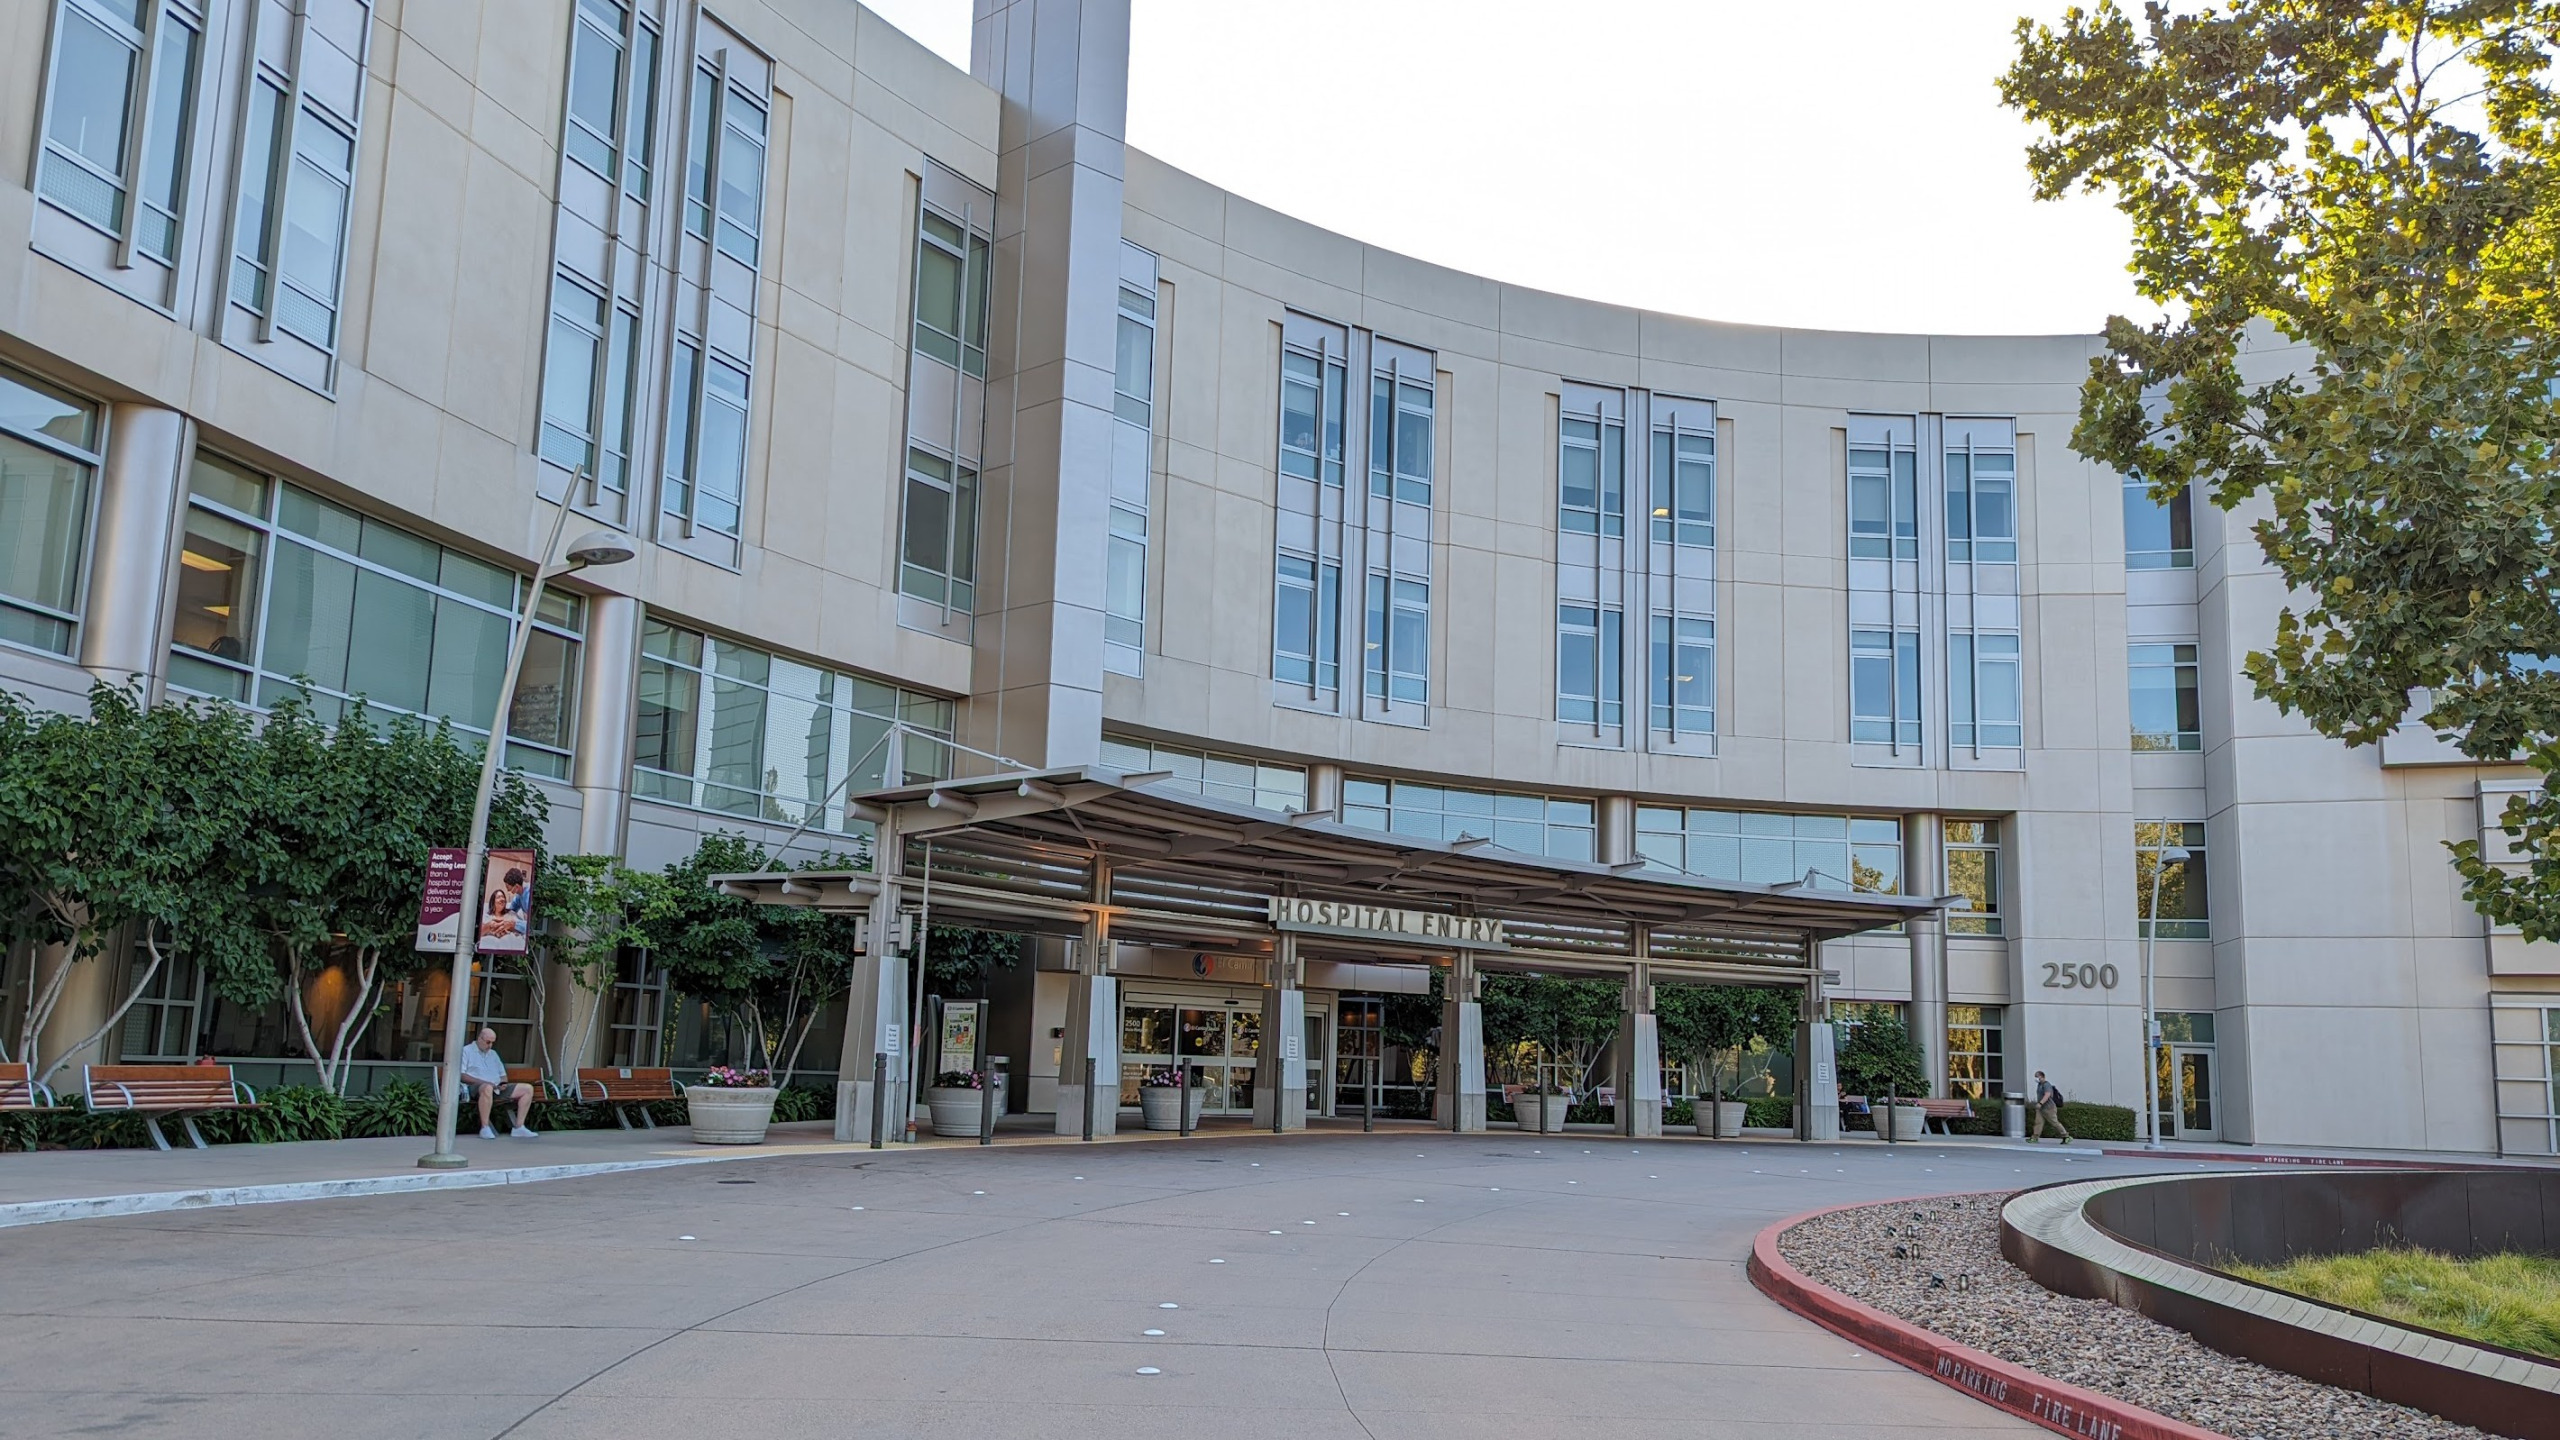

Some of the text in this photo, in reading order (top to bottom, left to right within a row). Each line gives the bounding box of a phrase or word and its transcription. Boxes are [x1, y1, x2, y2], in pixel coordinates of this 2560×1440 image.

[431, 862, 452, 870] Nothing
[1276, 897, 1500, 943] HOSPITAL ENTRY
[2042, 962, 2119, 989] 2500
[1125, 1019, 1141, 1027] 2500
[1936, 1356, 2122, 1440] NO PARKING FIRE LANE
